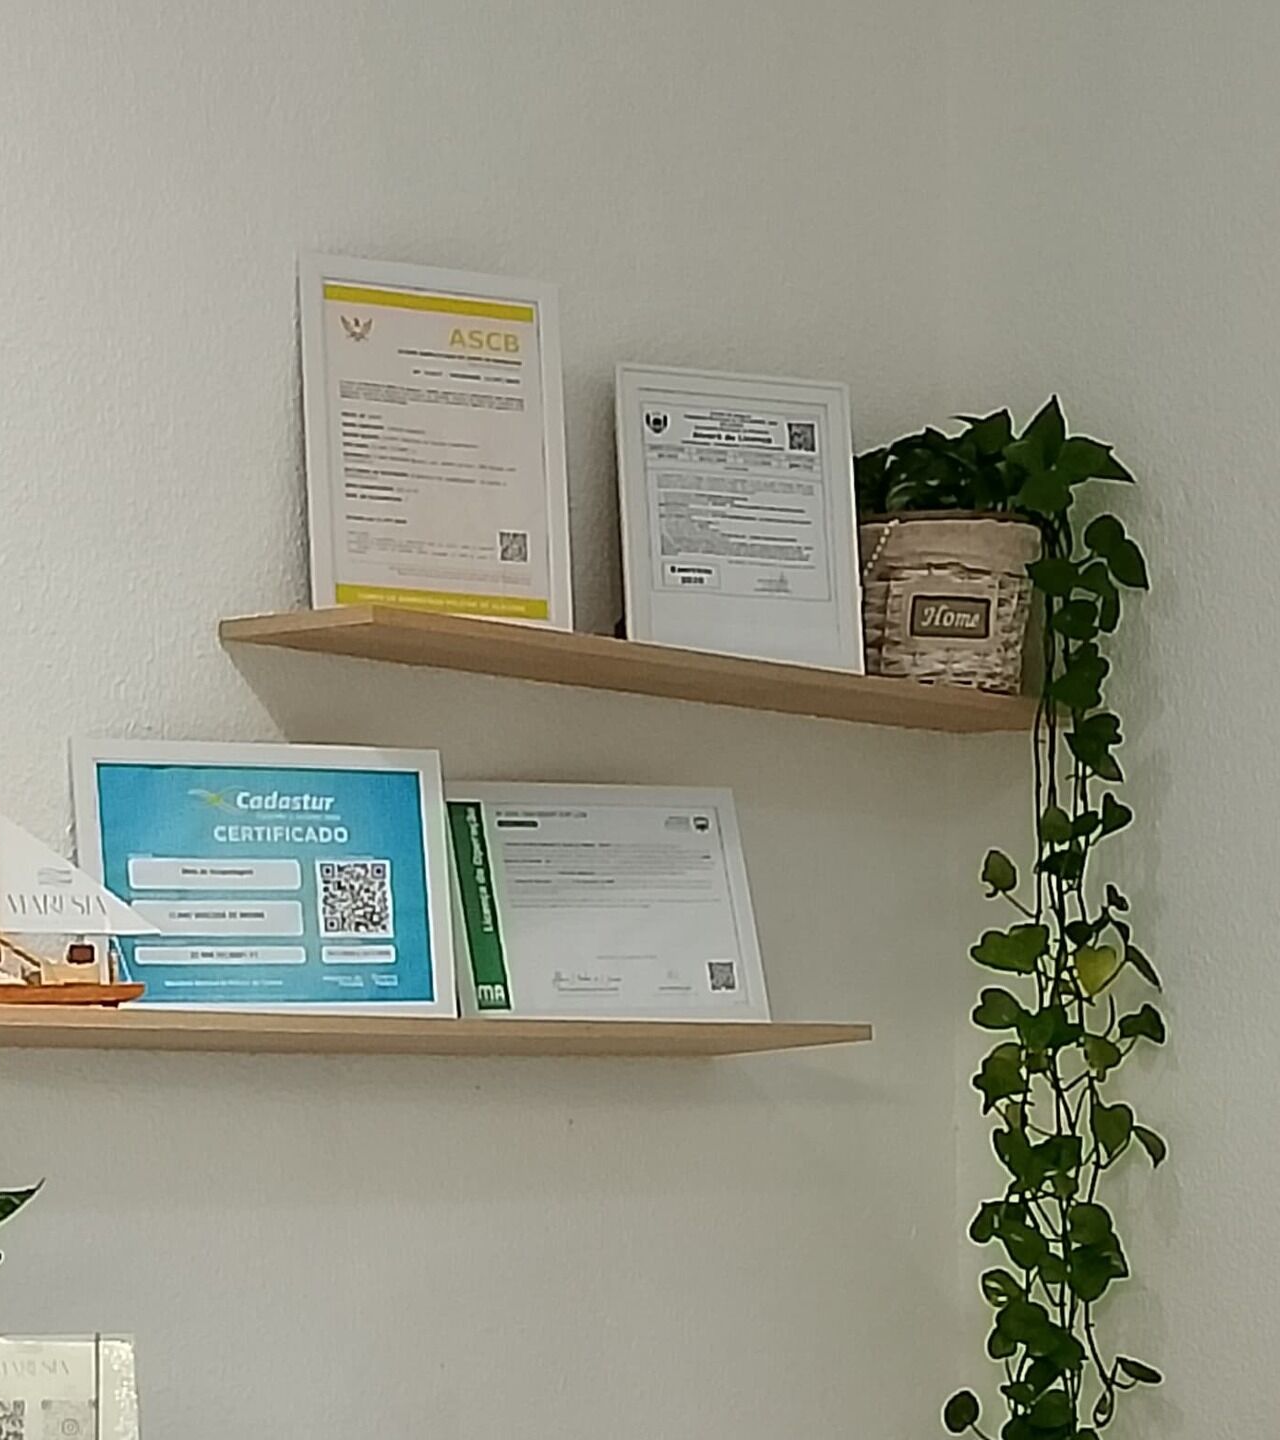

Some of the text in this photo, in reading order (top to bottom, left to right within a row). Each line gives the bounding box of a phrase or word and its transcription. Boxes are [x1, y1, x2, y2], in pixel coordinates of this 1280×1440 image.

[449, 328, 521, 353] ASCB
[921, 605, 981, 629] Home
[236, 790, 335, 812] Cadastur
[213, 824, 349, 845] CERTIFICADO
